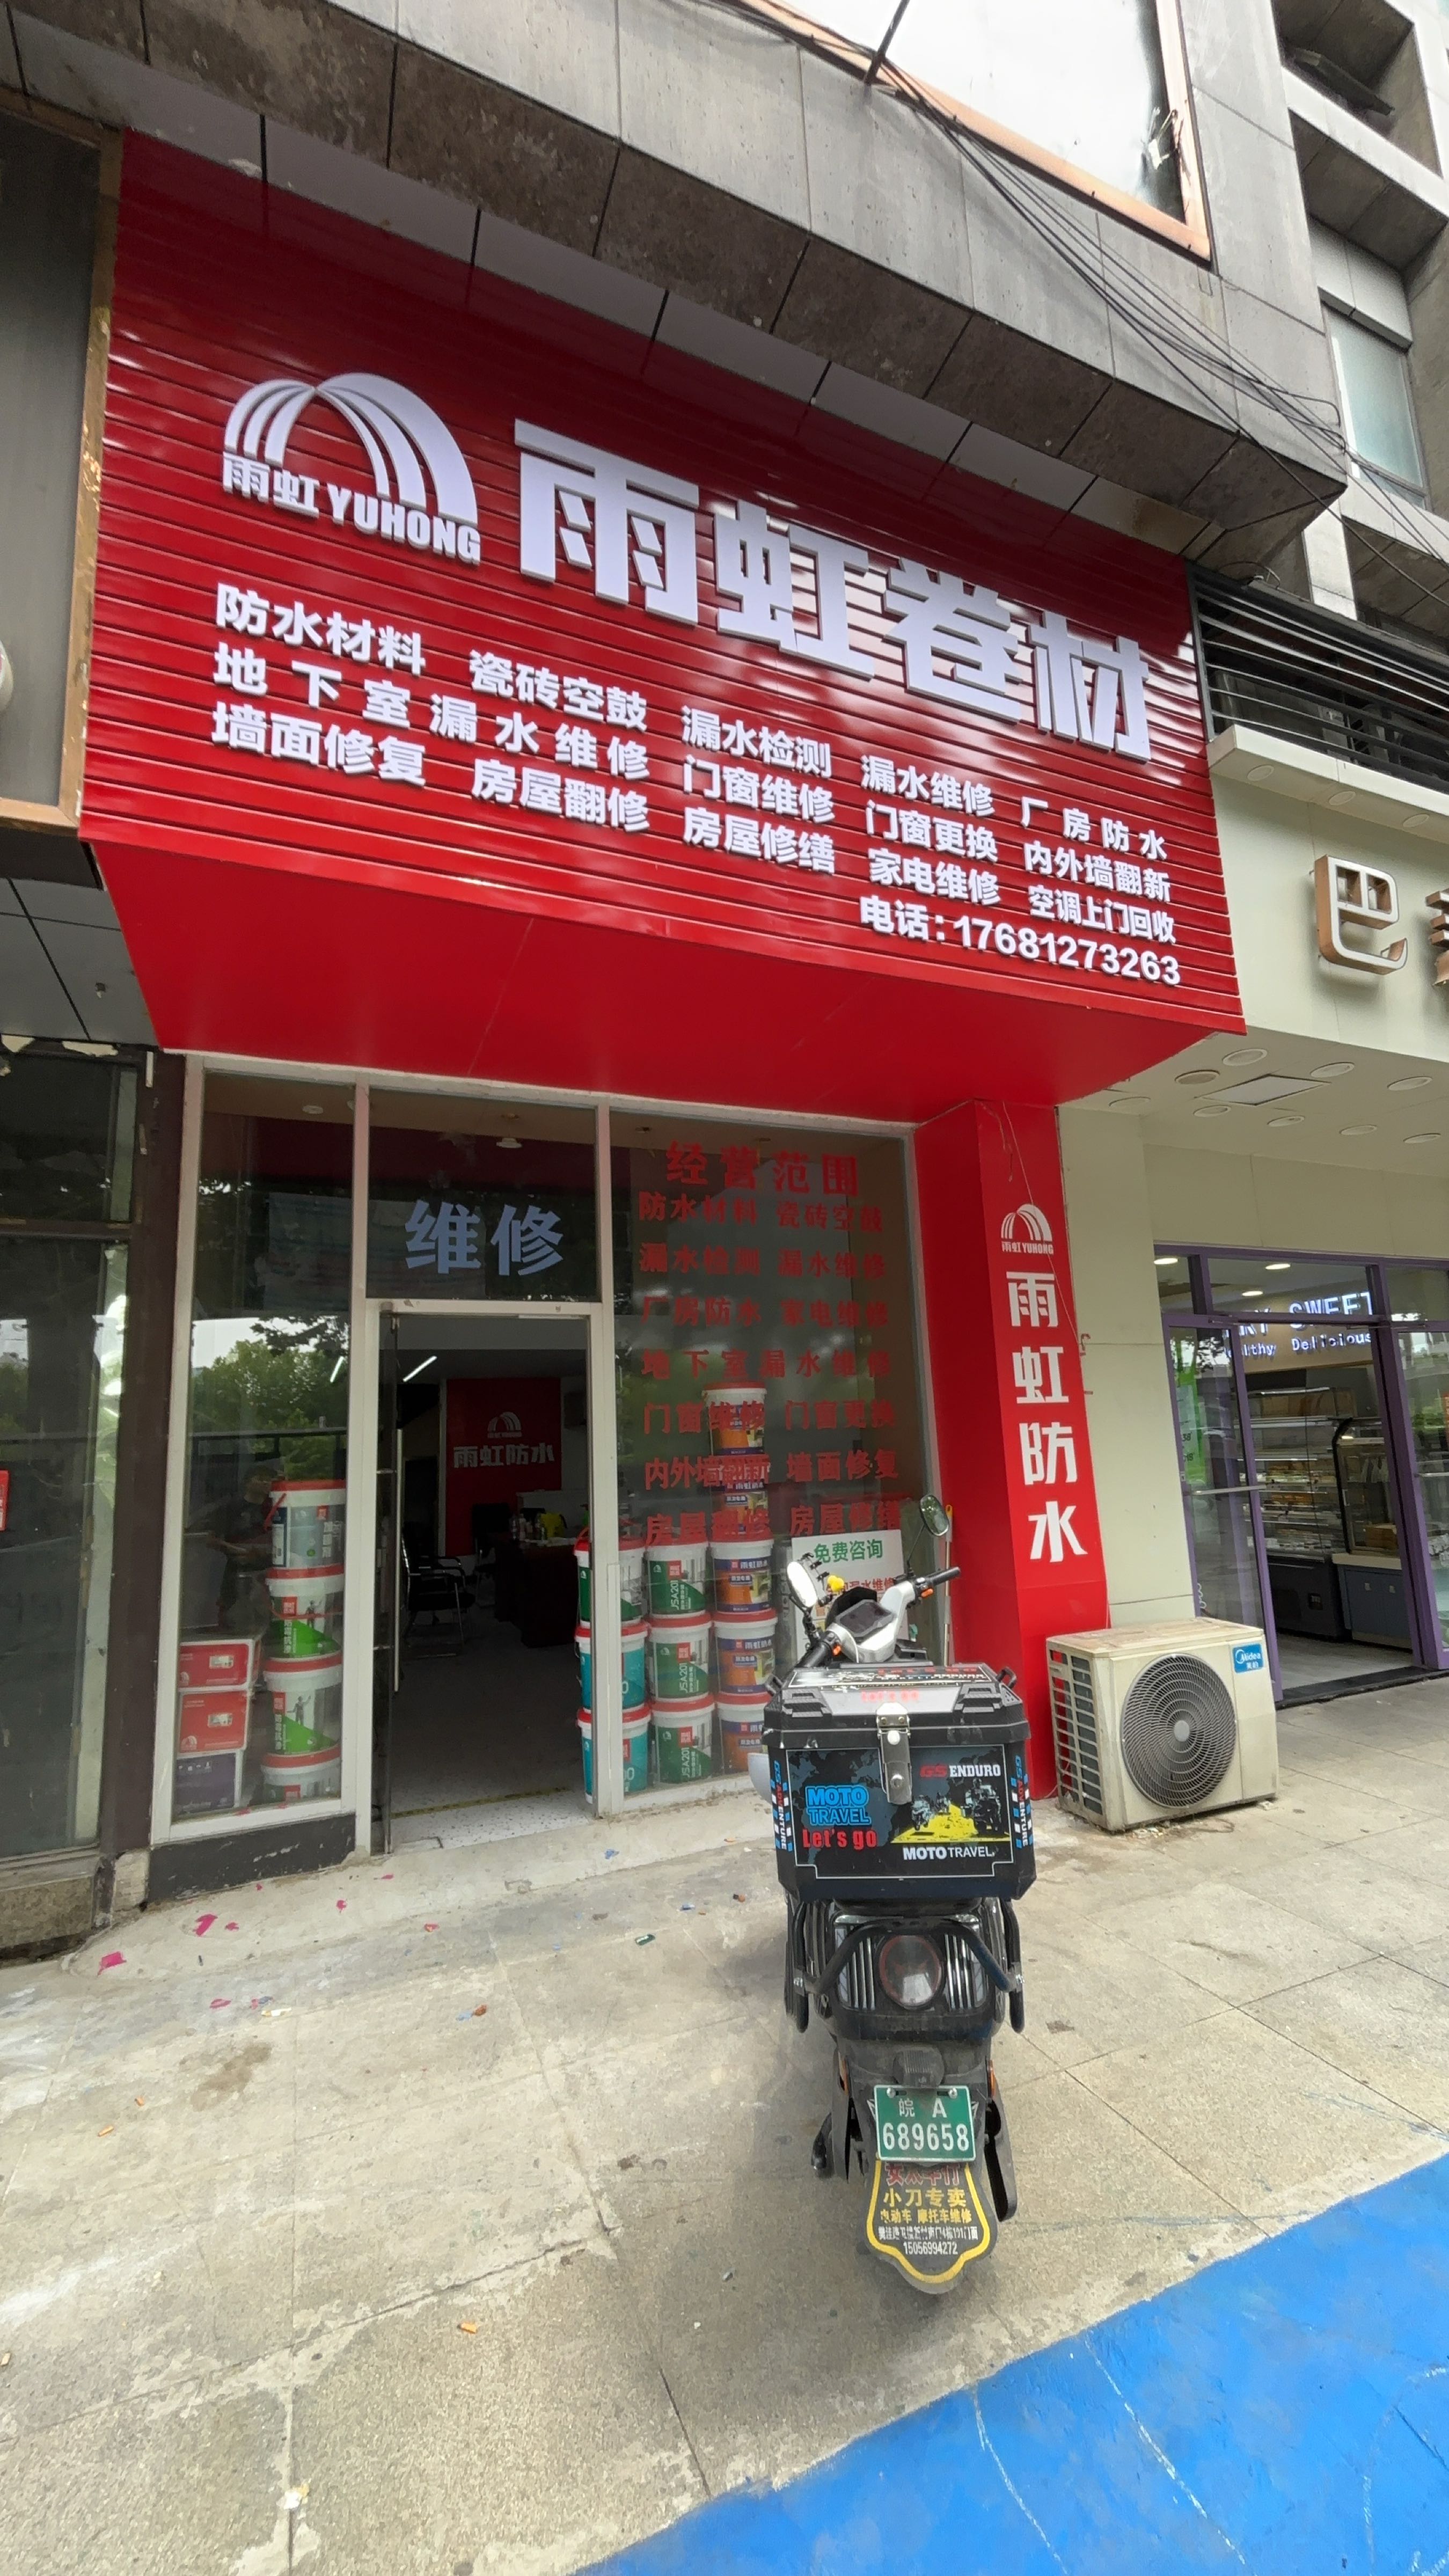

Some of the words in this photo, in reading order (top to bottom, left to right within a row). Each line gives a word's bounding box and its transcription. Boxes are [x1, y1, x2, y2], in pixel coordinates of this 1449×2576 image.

[223, 453, 319, 517] 雨虹
[327, 483, 481, 566] YUHONG
[514, 418, 1151, 763] 雨虹卷材
[216, 582, 426, 675] 防水材料
[469, 649, 647, 732] 瓷砖空鼓
[680, 705, 832, 779] 漏水检测
[860, 755, 996, 817] 漏水维修
[1020, 797, 1168, 861] 厂房防水
[211, 701, 426, 787] 墙面修复
[471, 758, 650, 833] 房屋翻修
[683, 806, 835, 875] 房屋修缮
[868, 848, 1000, 907] 家电维修
[1028, 884, 1176, 945] 空调上门回收
[683, 755, 835, 824] 门窗维修
[865, 800, 999, 863] 门窗更换
[1023, 840, 1170, 903] 内外墙翻新
[666, 1141, 858, 1197] 经营范围
[639, 1191, 756, 1227] 防水材料
[776, 1201, 883, 1233] 瓷砖空鼓
[405, 1199, 564, 1276] 维修
[1022, 1242, 1053, 1254] YUHONG
[639, 1243, 760, 1275] 漏水检测
[778, 1248, 886, 1280] 漏水维修
[641, 1296, 761, 1328] 厂房防水
[781, 1299, 889, 1328] 家电维修
[641, 1349, 891, 1380] 地下室漏水维修
[644, 1400, 766, 1434] 门窗维修
[785, 1400, 895, 1430] 门窗更换
[1006, 1271, 1088, 1562] 雨虹防水
[453, 1443, 554, 1468] 雨虹防水
[786, 1449, 898, 1483] 墙面修复
[814, 1539, 883, 1563] 免费咨询
[670, 1580, 679, 1610] JSA201
[1235, 1649, 1261, 1664] Midea
[681, 1747, 690, 1777] JSA201
[949, 1765, 1000, 1777] ENDURO
[807, 1786, 868, 1806] MOTO
[776, 1783, 787, 1850] ADVENTURE
[809, 1807, 872, 1826] TRAVEL
[1018, 1779, 1028, 1847] ADVENTURE
[802, 1829, 847, 1849] Let's
[853, 1831, 877, 1850] go
[899, 2098, 915, 2118] 皖
[932, 2098, 947, 2118] A
[883, 2123, 969, 2151] 689658
[883, 2187, 967, 2207] 小刀专卖
[880, 2208, 912, 2224] 电动车
[917, 2208, 972, 2224] 摩托车维修
[903, 2241, 958, 2255] 15056994272
